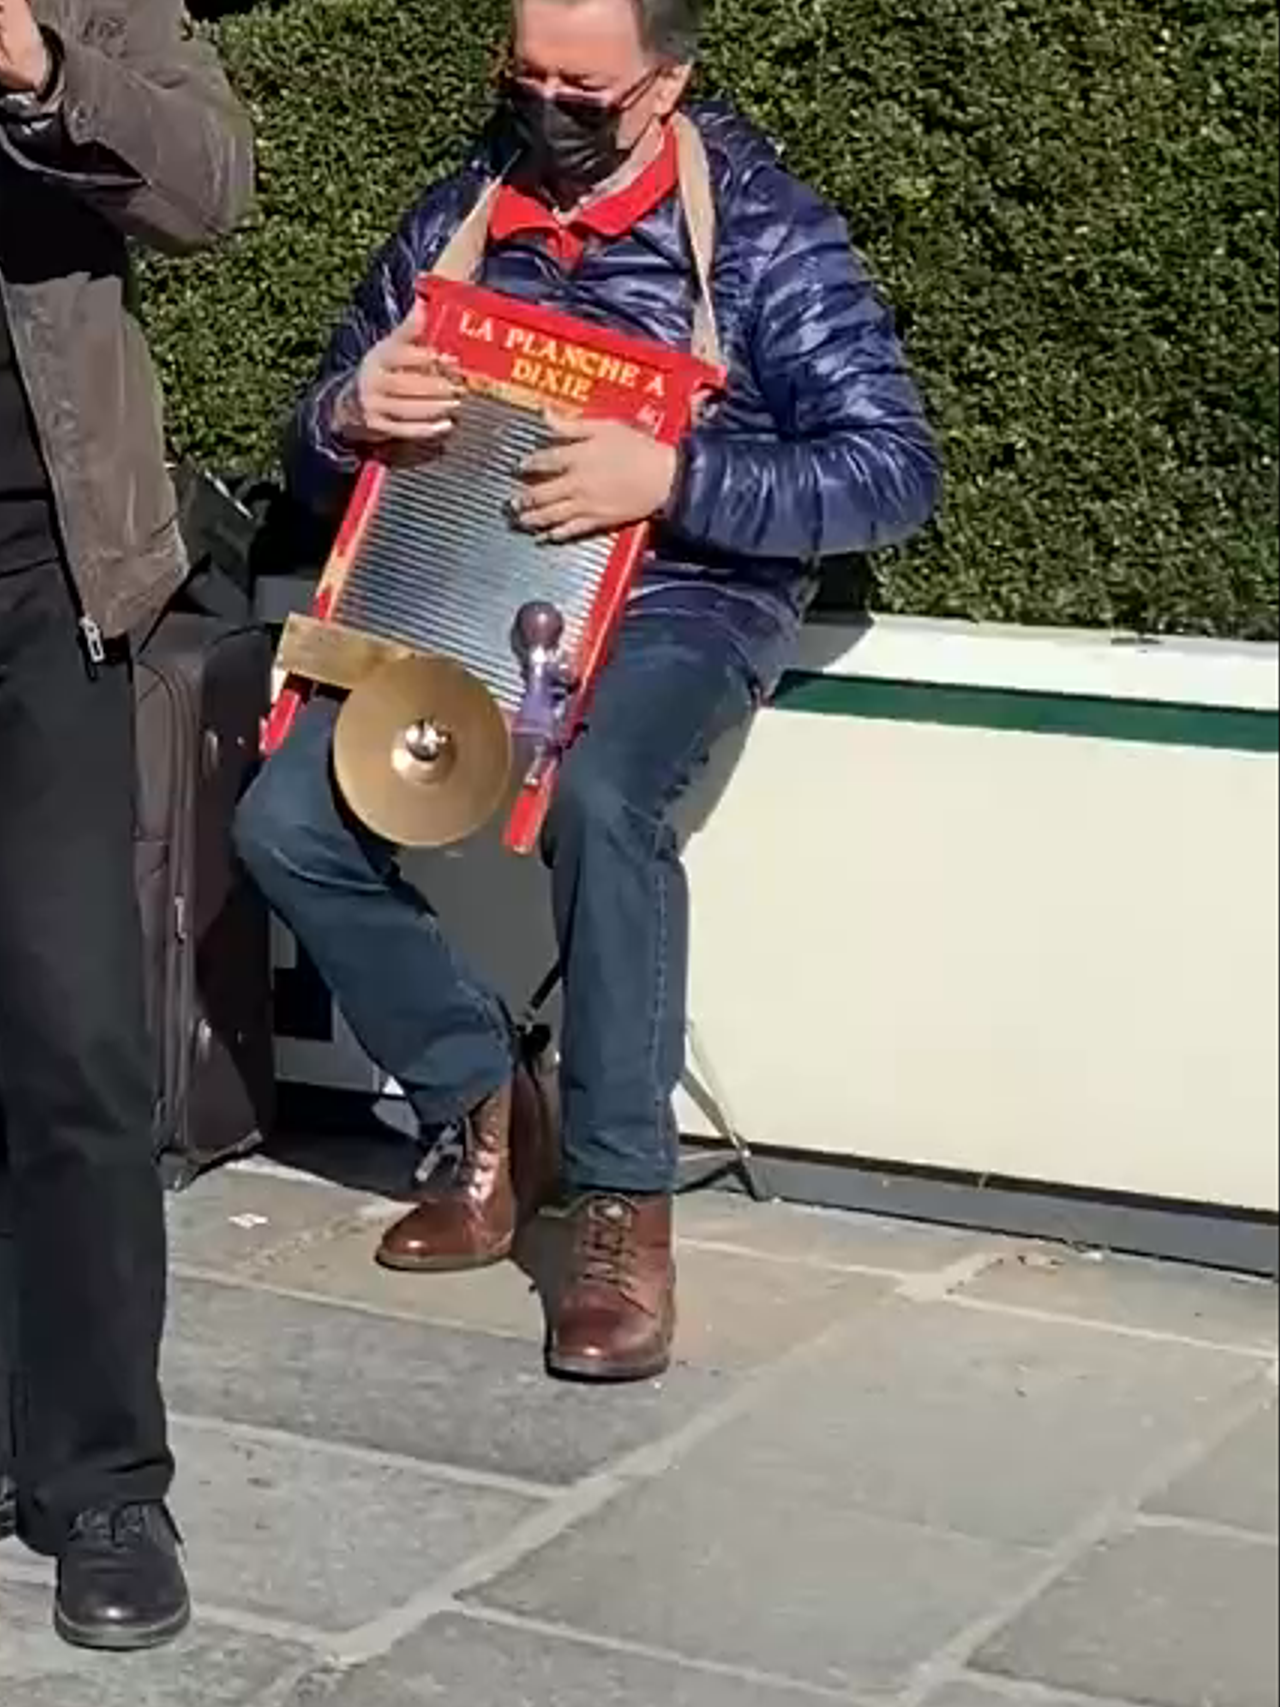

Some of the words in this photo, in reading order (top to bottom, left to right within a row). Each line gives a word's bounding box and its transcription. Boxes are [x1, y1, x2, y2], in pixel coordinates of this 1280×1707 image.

[459, 310, 494, 342] LA
[505, 327, 640, 388] PLANCHE
[643, 374, 665, 398] A
[511, 357, 593, 403] DIXIE
